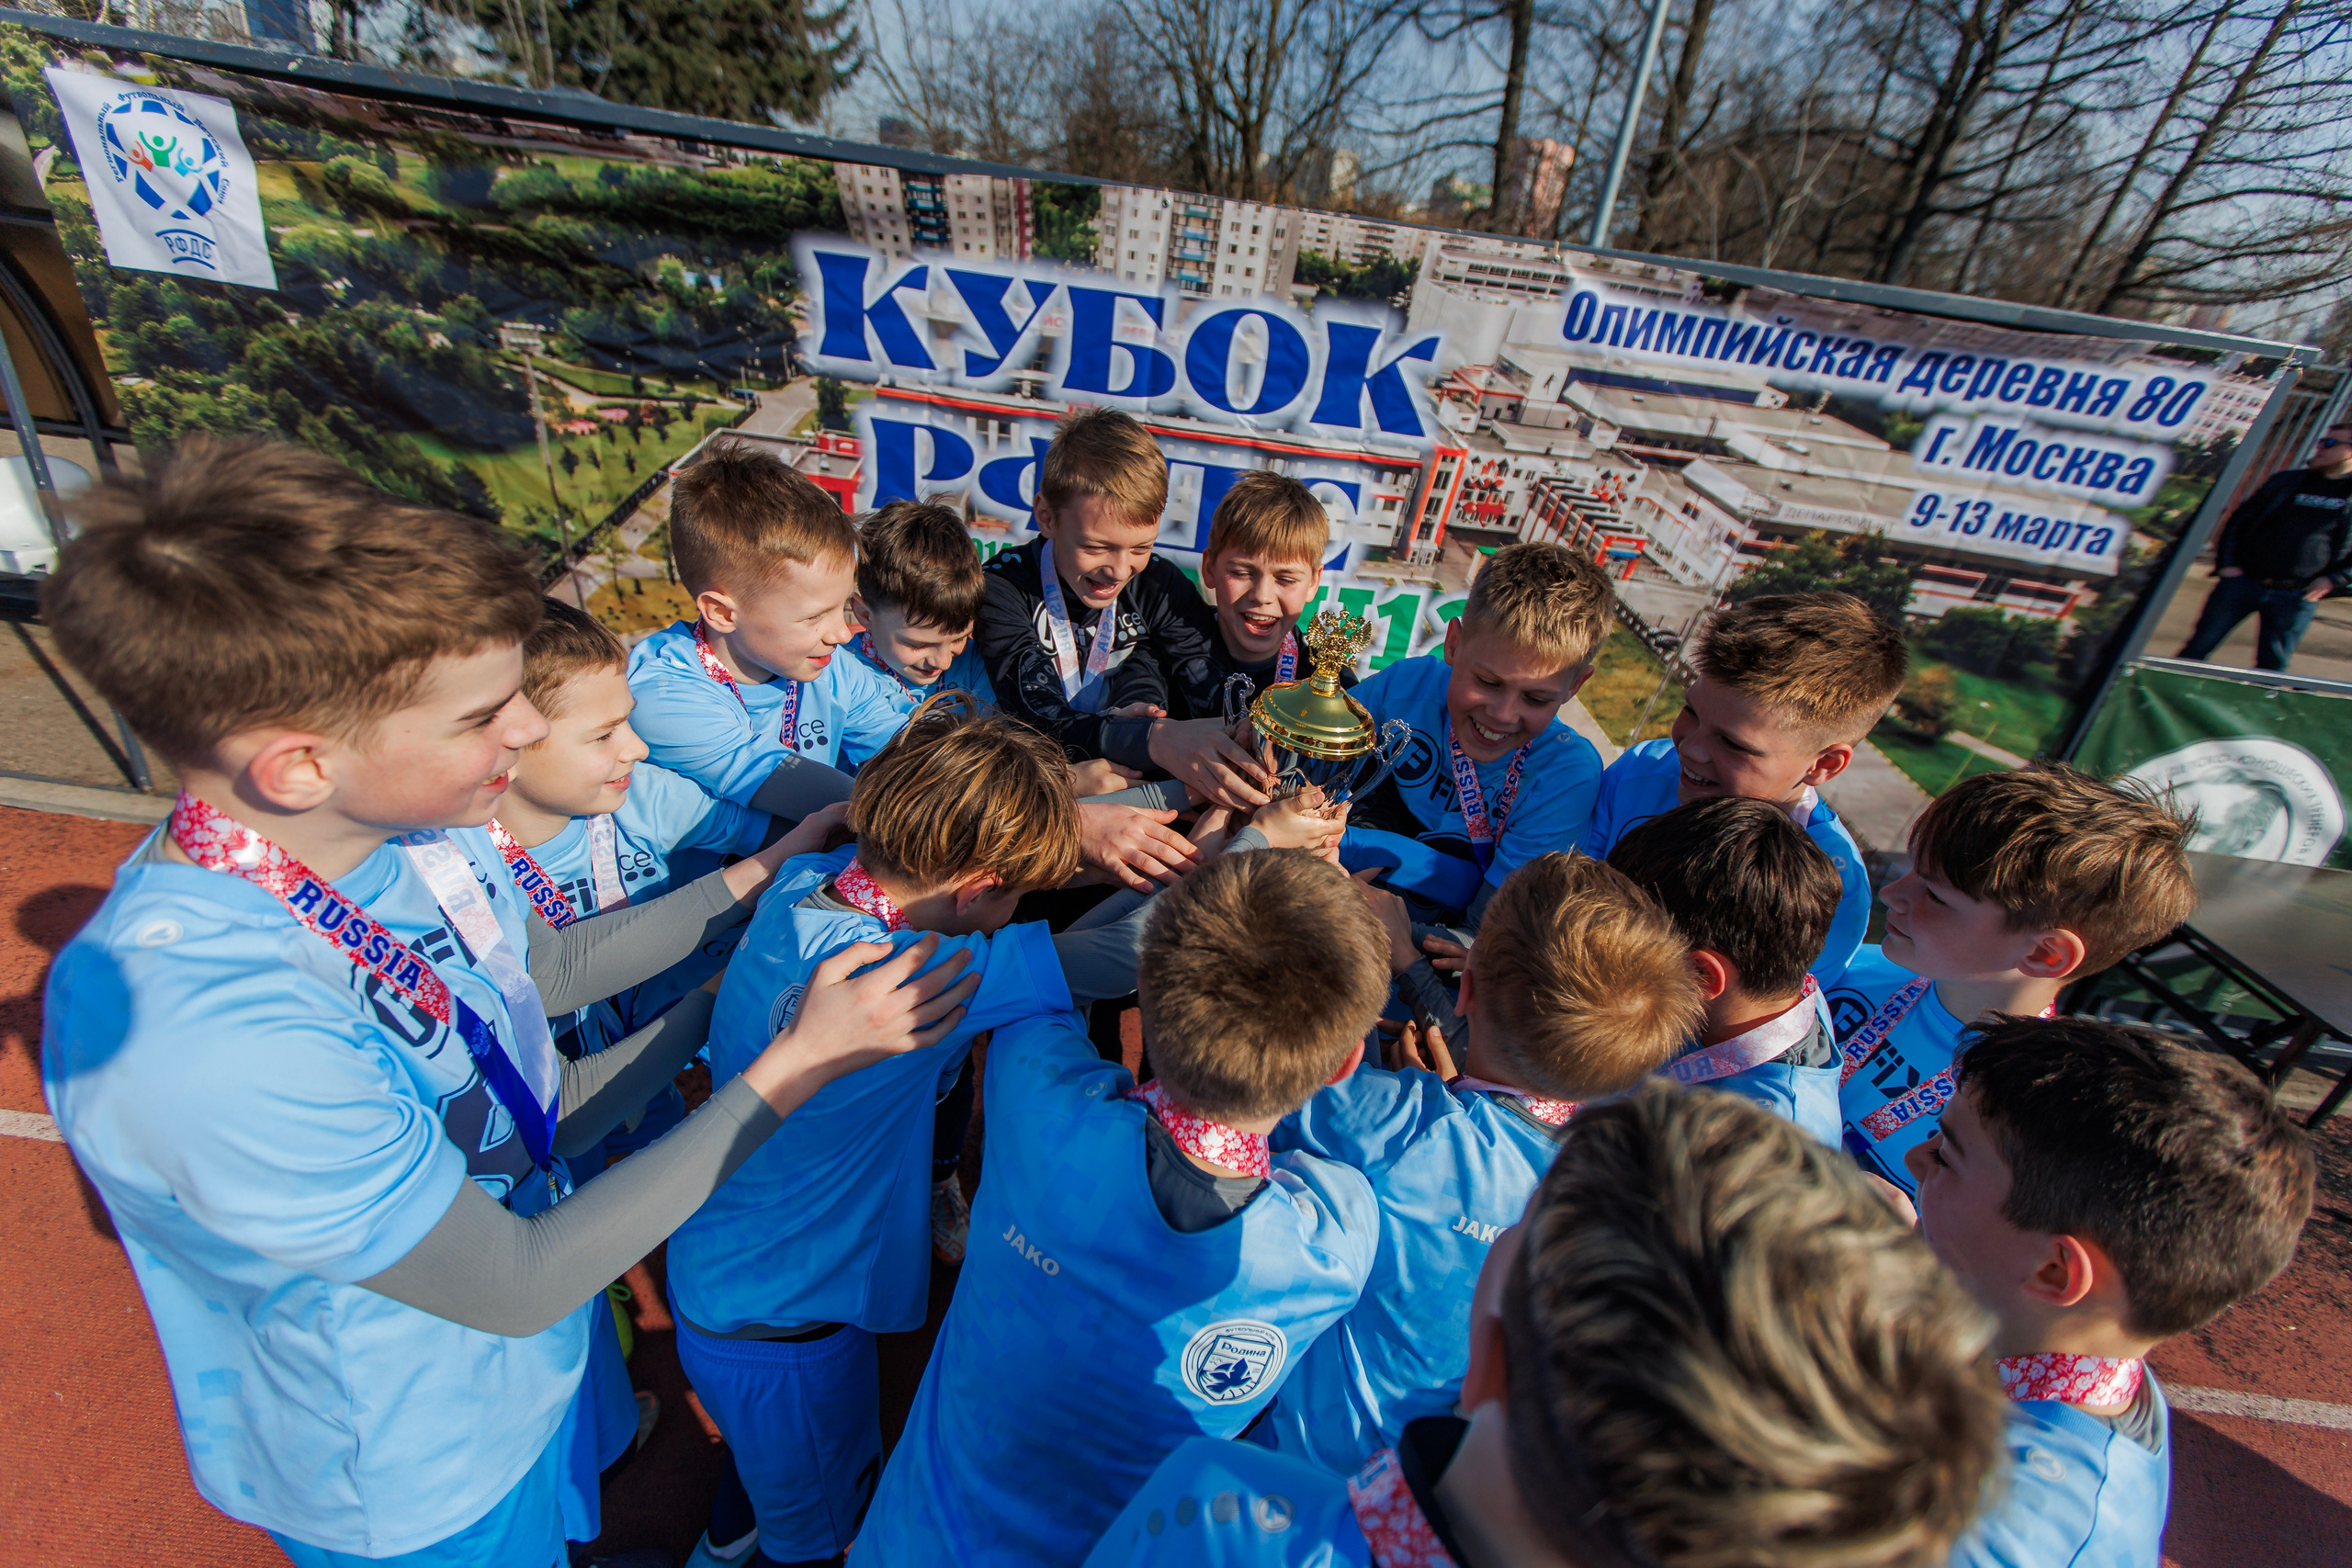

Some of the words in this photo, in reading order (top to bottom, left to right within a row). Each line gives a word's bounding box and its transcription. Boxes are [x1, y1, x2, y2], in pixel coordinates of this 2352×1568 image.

[163, 234, 212, 260] РФДС
[813, 249, 1442, 437] КУБОК
[1562, 290, 1906, 384] Олимпийская
[1897, 350, 2132, 419] деревня
[2127, 375, 2208, 427] 80
[1923, 424, 1951, 465] г.
[1957, 423, 2156, 496] Москва
[1910, 493, 1992, 536] 9-13
[1991, 512, 2114, 556] марта
[1452, 739, 1482, 817] RUSSIA
[511, 857, 577, 931] RUSSI
[288, 878, 423, 992] RUSSIA
[1846, 984, 1924, 1061] RUSSIA
[1002, 1224, 1060, 1277] JAKO
[1221, 1342, 1267, 1357] Родина
